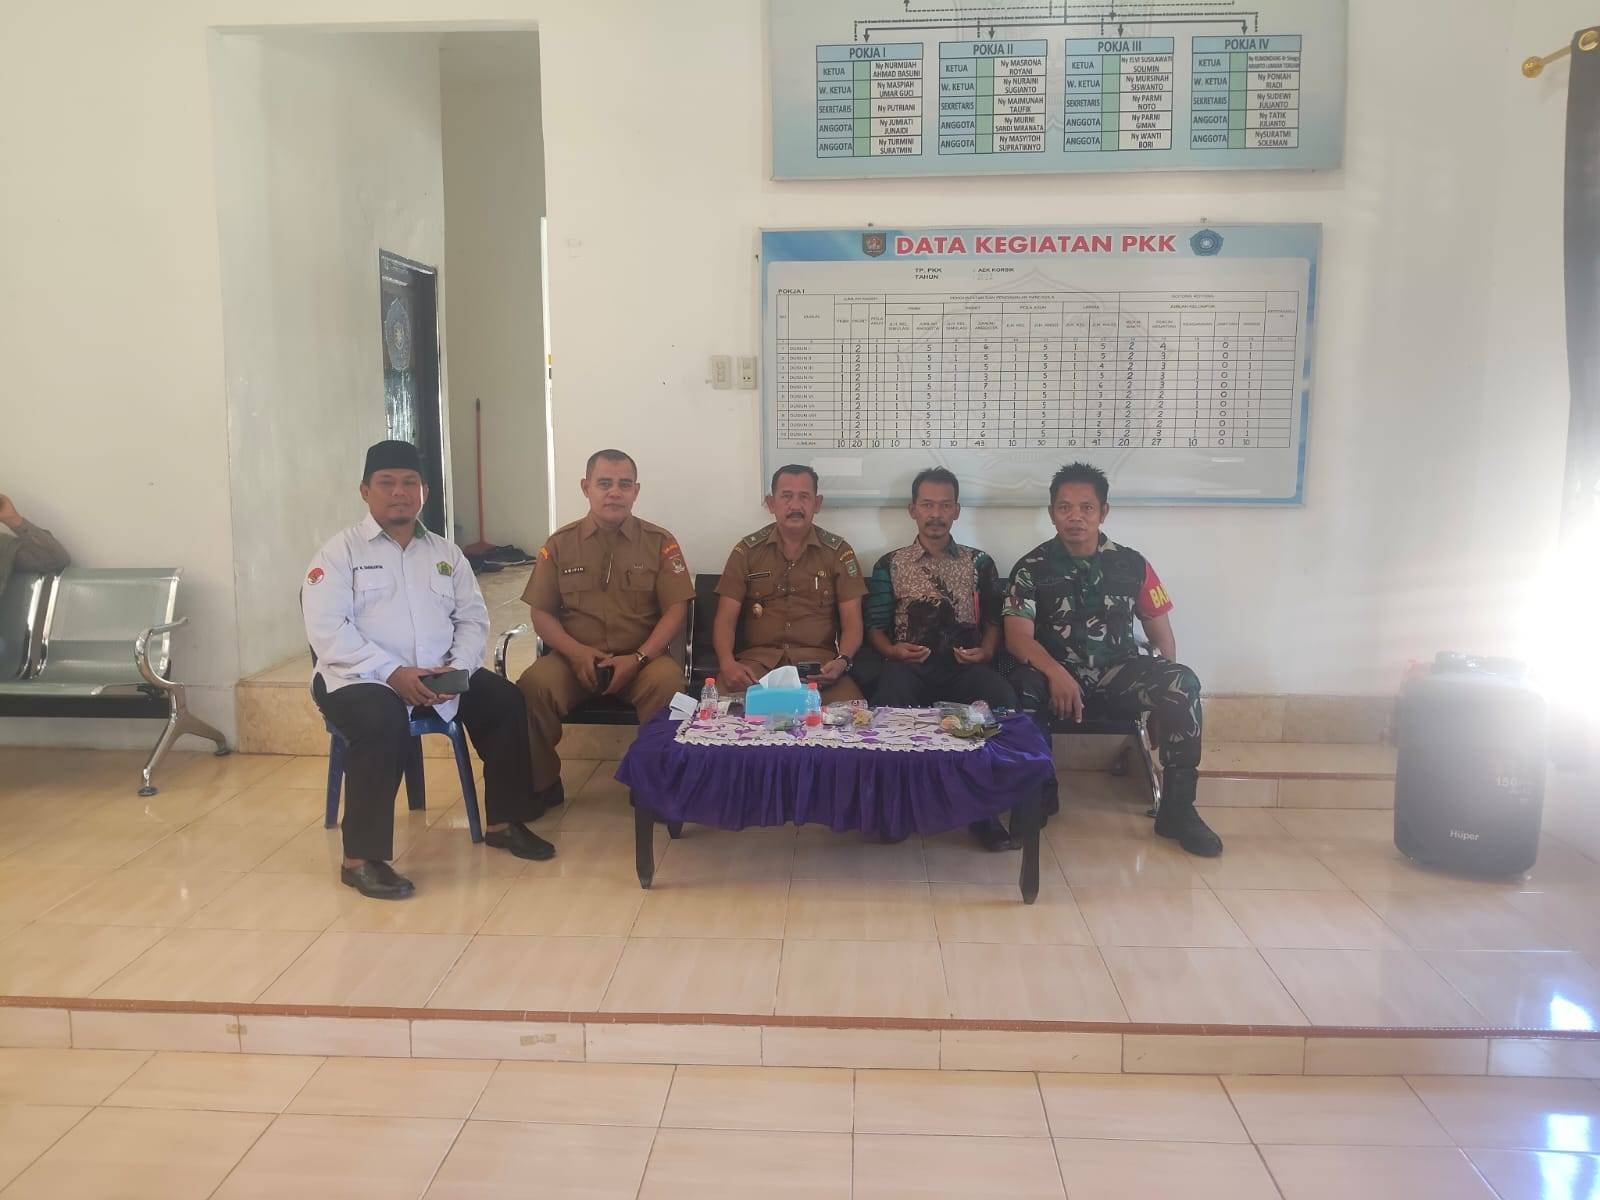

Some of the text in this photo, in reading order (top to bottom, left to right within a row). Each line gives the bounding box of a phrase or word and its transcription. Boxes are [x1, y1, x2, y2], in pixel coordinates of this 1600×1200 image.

[973, 44, 1004, 55] POKJA
[1098, 41, 1141, 52] POKJA III
[1225, 39, 1256, 50] POKJA
[850, 47, 880, 58] POKJA
[896, 235, 1176, 254] DATA KEGIATAN PKK
[1149, 584, 1169, 608] BA
